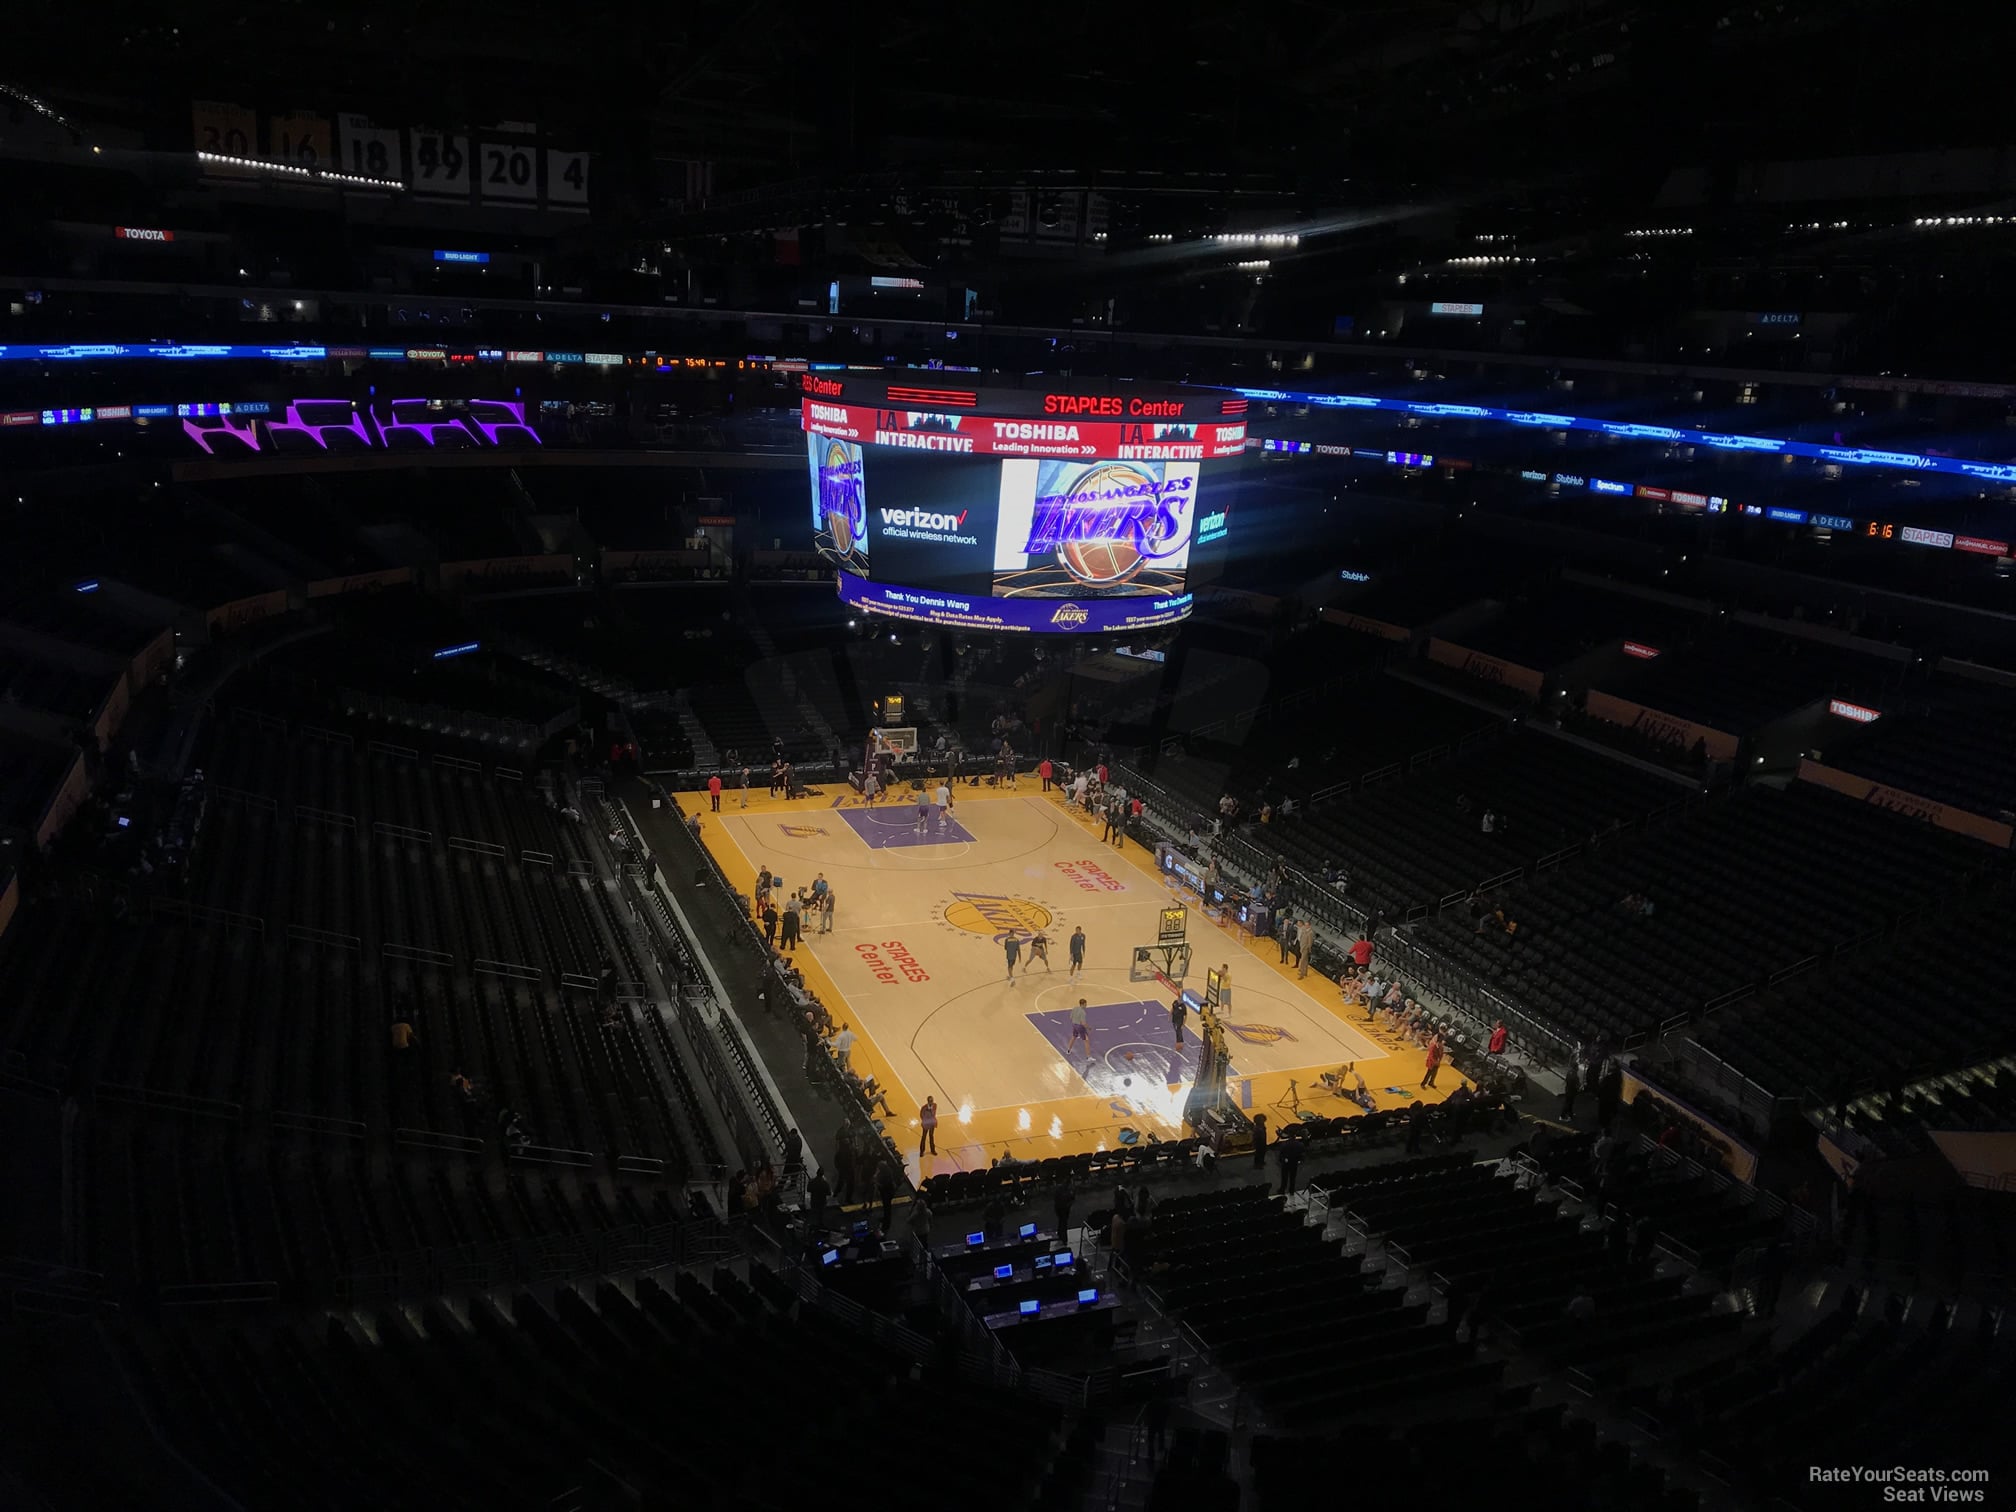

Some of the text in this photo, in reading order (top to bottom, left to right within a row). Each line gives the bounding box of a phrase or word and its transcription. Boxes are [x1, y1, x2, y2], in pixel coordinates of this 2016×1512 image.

[352, 140, 389, 174] 18
[488, 150, 530, 186] 20
[564, 157, 584, 190] 4
[124, 228, 166, 241] TOYOTA
[1441, 304, 1474, 313] STAPLES
[1771, 314, 1799, 323] DELTA
[418, 350, 446, 359] TOYOTA
[555, 353, 583, 361] DELTA
[586, 354, 622, 364] STAPLES
[814, 377, 843, 396] Center
[97, 407, 131, 418] TOSHIBA
[244, 403, 270, 413] DELTA
[811, 404, 848, 424] TOSHIBA
[1043, 394, 1185, 417] STAPLES Center
[876, 410, 898, 431] LA
[993, 422, 1080, 441] TOSHIBA
[1120, 424, 1144, 444] LA
[875, 430, 974, 453] INTERACTIVE
[993, 442, 1079, 455] Leading Innovation
[1316, 444, 1351, 456] TOYOTA
[1118, 445, 1204, 459] INTERACTIVE
[1521, 469, 1547, 481] verizon
[1556, 473, 1585, 486] StubHub
[1099, 477, 1193, 502] ANGELES
[1597, 480, 1625, 492] Spectrum
[1672, 491, 1707, 507] TOSHIBA
[881, 506, 958, 531] verizon
[1017, 496, 1193, 560] LAKERS
[1820, 514, 1853, 529] DELTA
[883, 527, 978, 546] official wireless network
[1903, 528, 1952, 547] STAPLES
[885, 589, 970, 612] Thank You Dennis Wang
[1050, 609, 1089, 624] LAKERS
[1054, 861, 1101, 893] Center
[1075, 859, 1126, 893] STAPLES
[855, 943, 900, 985] Center
[881, 940, 930, 984] STAPLES
